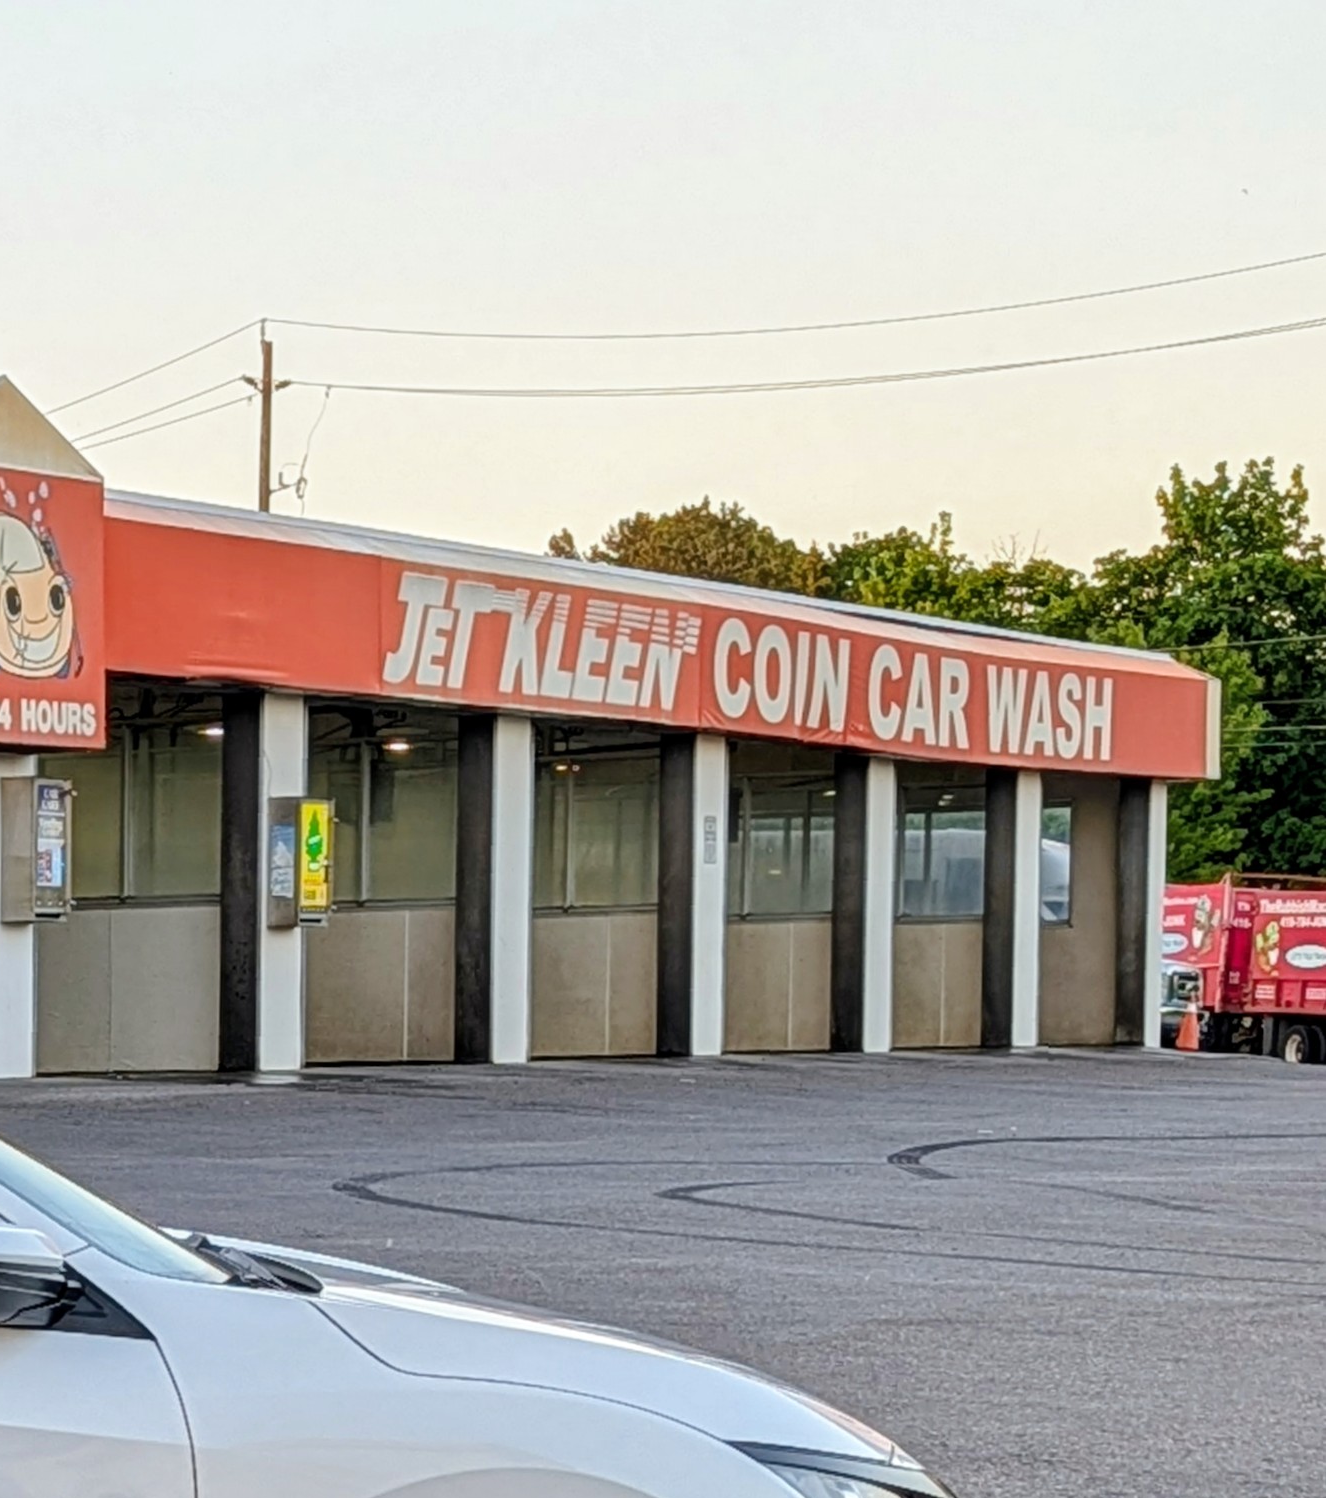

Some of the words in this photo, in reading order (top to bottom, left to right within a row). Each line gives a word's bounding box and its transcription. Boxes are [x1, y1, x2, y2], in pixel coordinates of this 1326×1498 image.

[21, 698, 97, 737] HOURS
[381, 571, 495, 689] JET
[498, 588, 702, 712] KLEEN
[713, 617, 851, 732] COIN
[868, 644, 970, 750] CAR
[986, 664, 1114, 761] WASH
